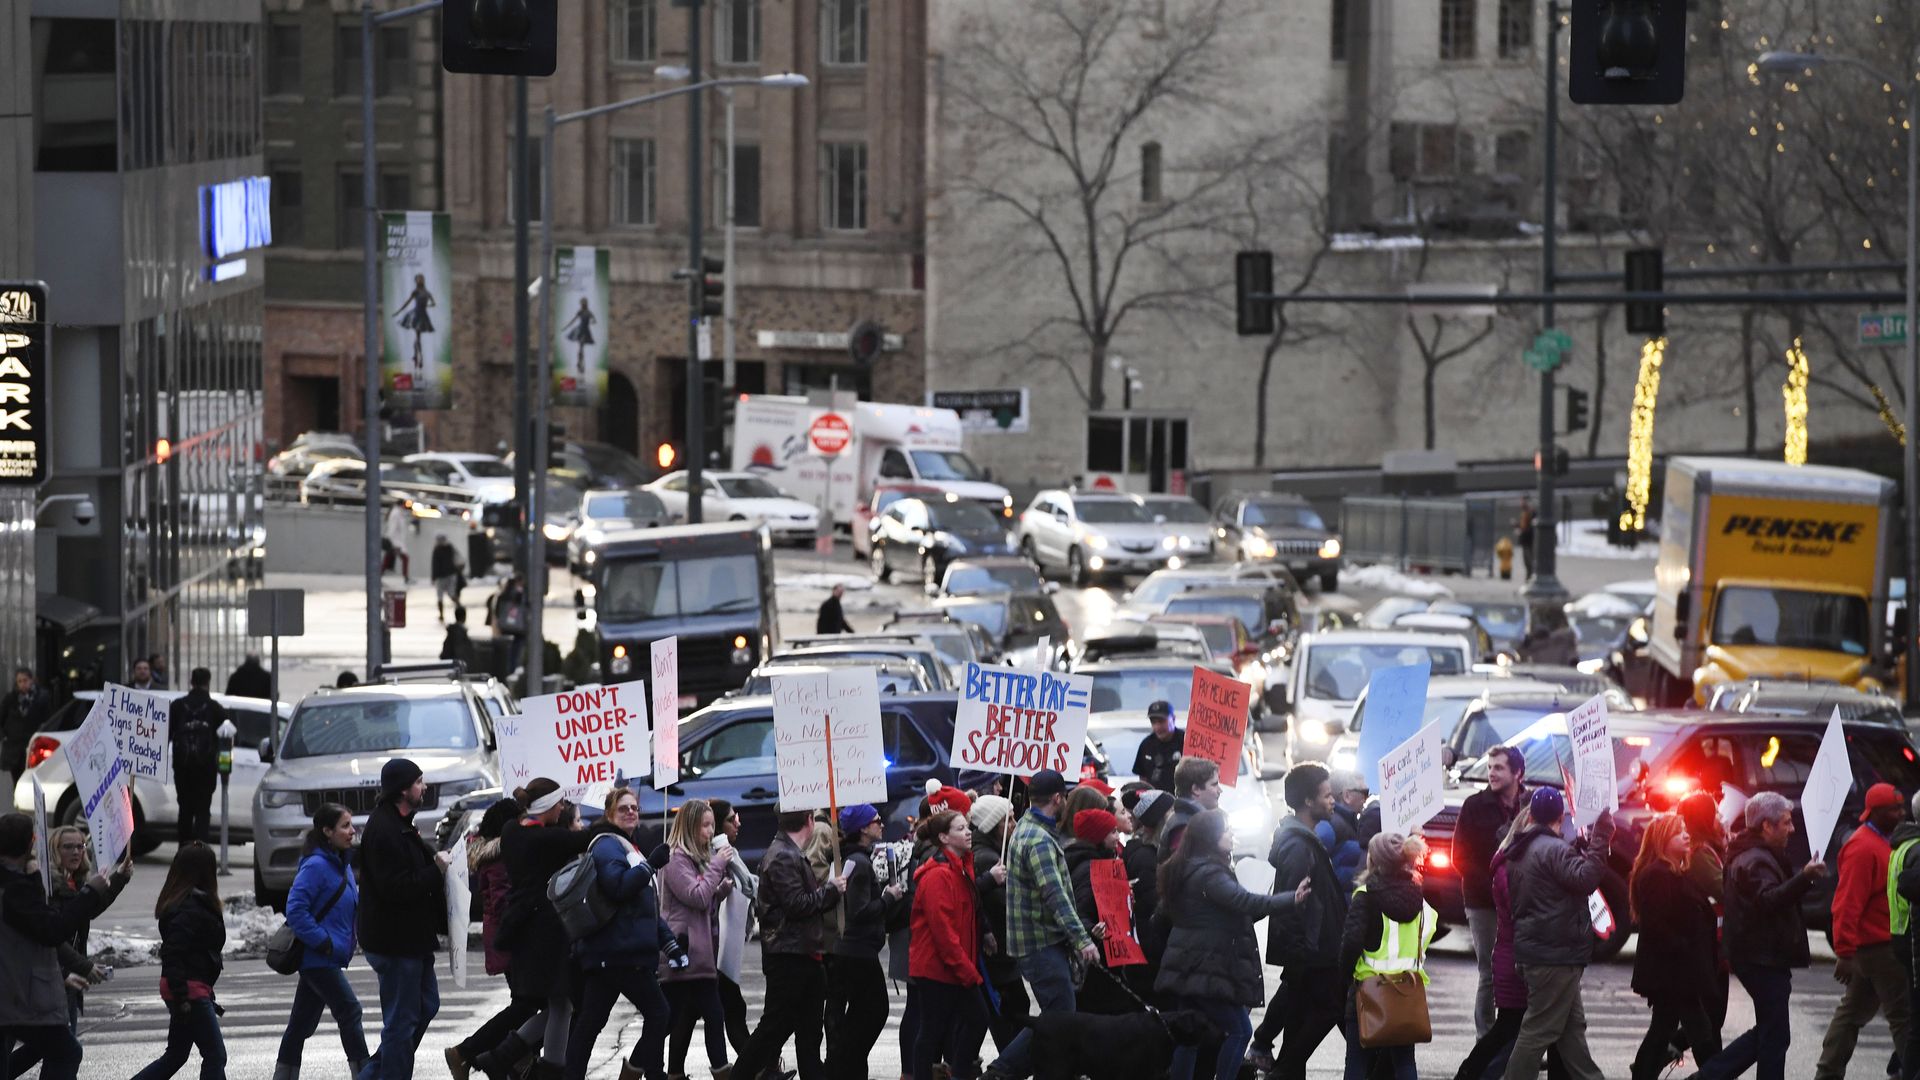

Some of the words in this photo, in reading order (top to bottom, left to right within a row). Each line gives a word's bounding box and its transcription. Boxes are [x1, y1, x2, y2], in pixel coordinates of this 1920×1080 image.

[386, 225, 407, 236] THE
[1722, 514, 1865, 544] PENSKE
[772, 680, 819, 707] Picket
[826, 673, 862, 700] Lines
[965, 663, 1037, 710] BETTER
[1198, 678, 1211, 698] PAY
[1209, 684, 1220, 704] ME
[1219, 687, 1240, 709] LIKE
[109, 688, 117, 709] I
[120, 691, 144, 717] Have
[145, 698, 167, 723] More
[556, 687, 619, 714] DON'T
[1190, 702, 1196, 719] A
[107, 709, 132, 736] Signs
[136, 718, 157, 740] But
[500, 721, 519, 737] We
[555, 708, 637, 740] UNDER-
[775, 727, 792, 743] Do
[833, 720, 869, 736] Cross
[986, 704, 1057, 742] BETTER
[128, 735, 162, 762] Reached
[558, 733, 625, 763] VALUE
[847, 744, 865, 759] On
[961, 730, 1070, 773] SCHOOLS
[136, 757, 157, 777] Limit
[512, 763, 530, 778] We
[577, 760, 615, 784] ME!
[835, 767, 882, 789] Teachers
[1382, 762, 1396, 790] You
